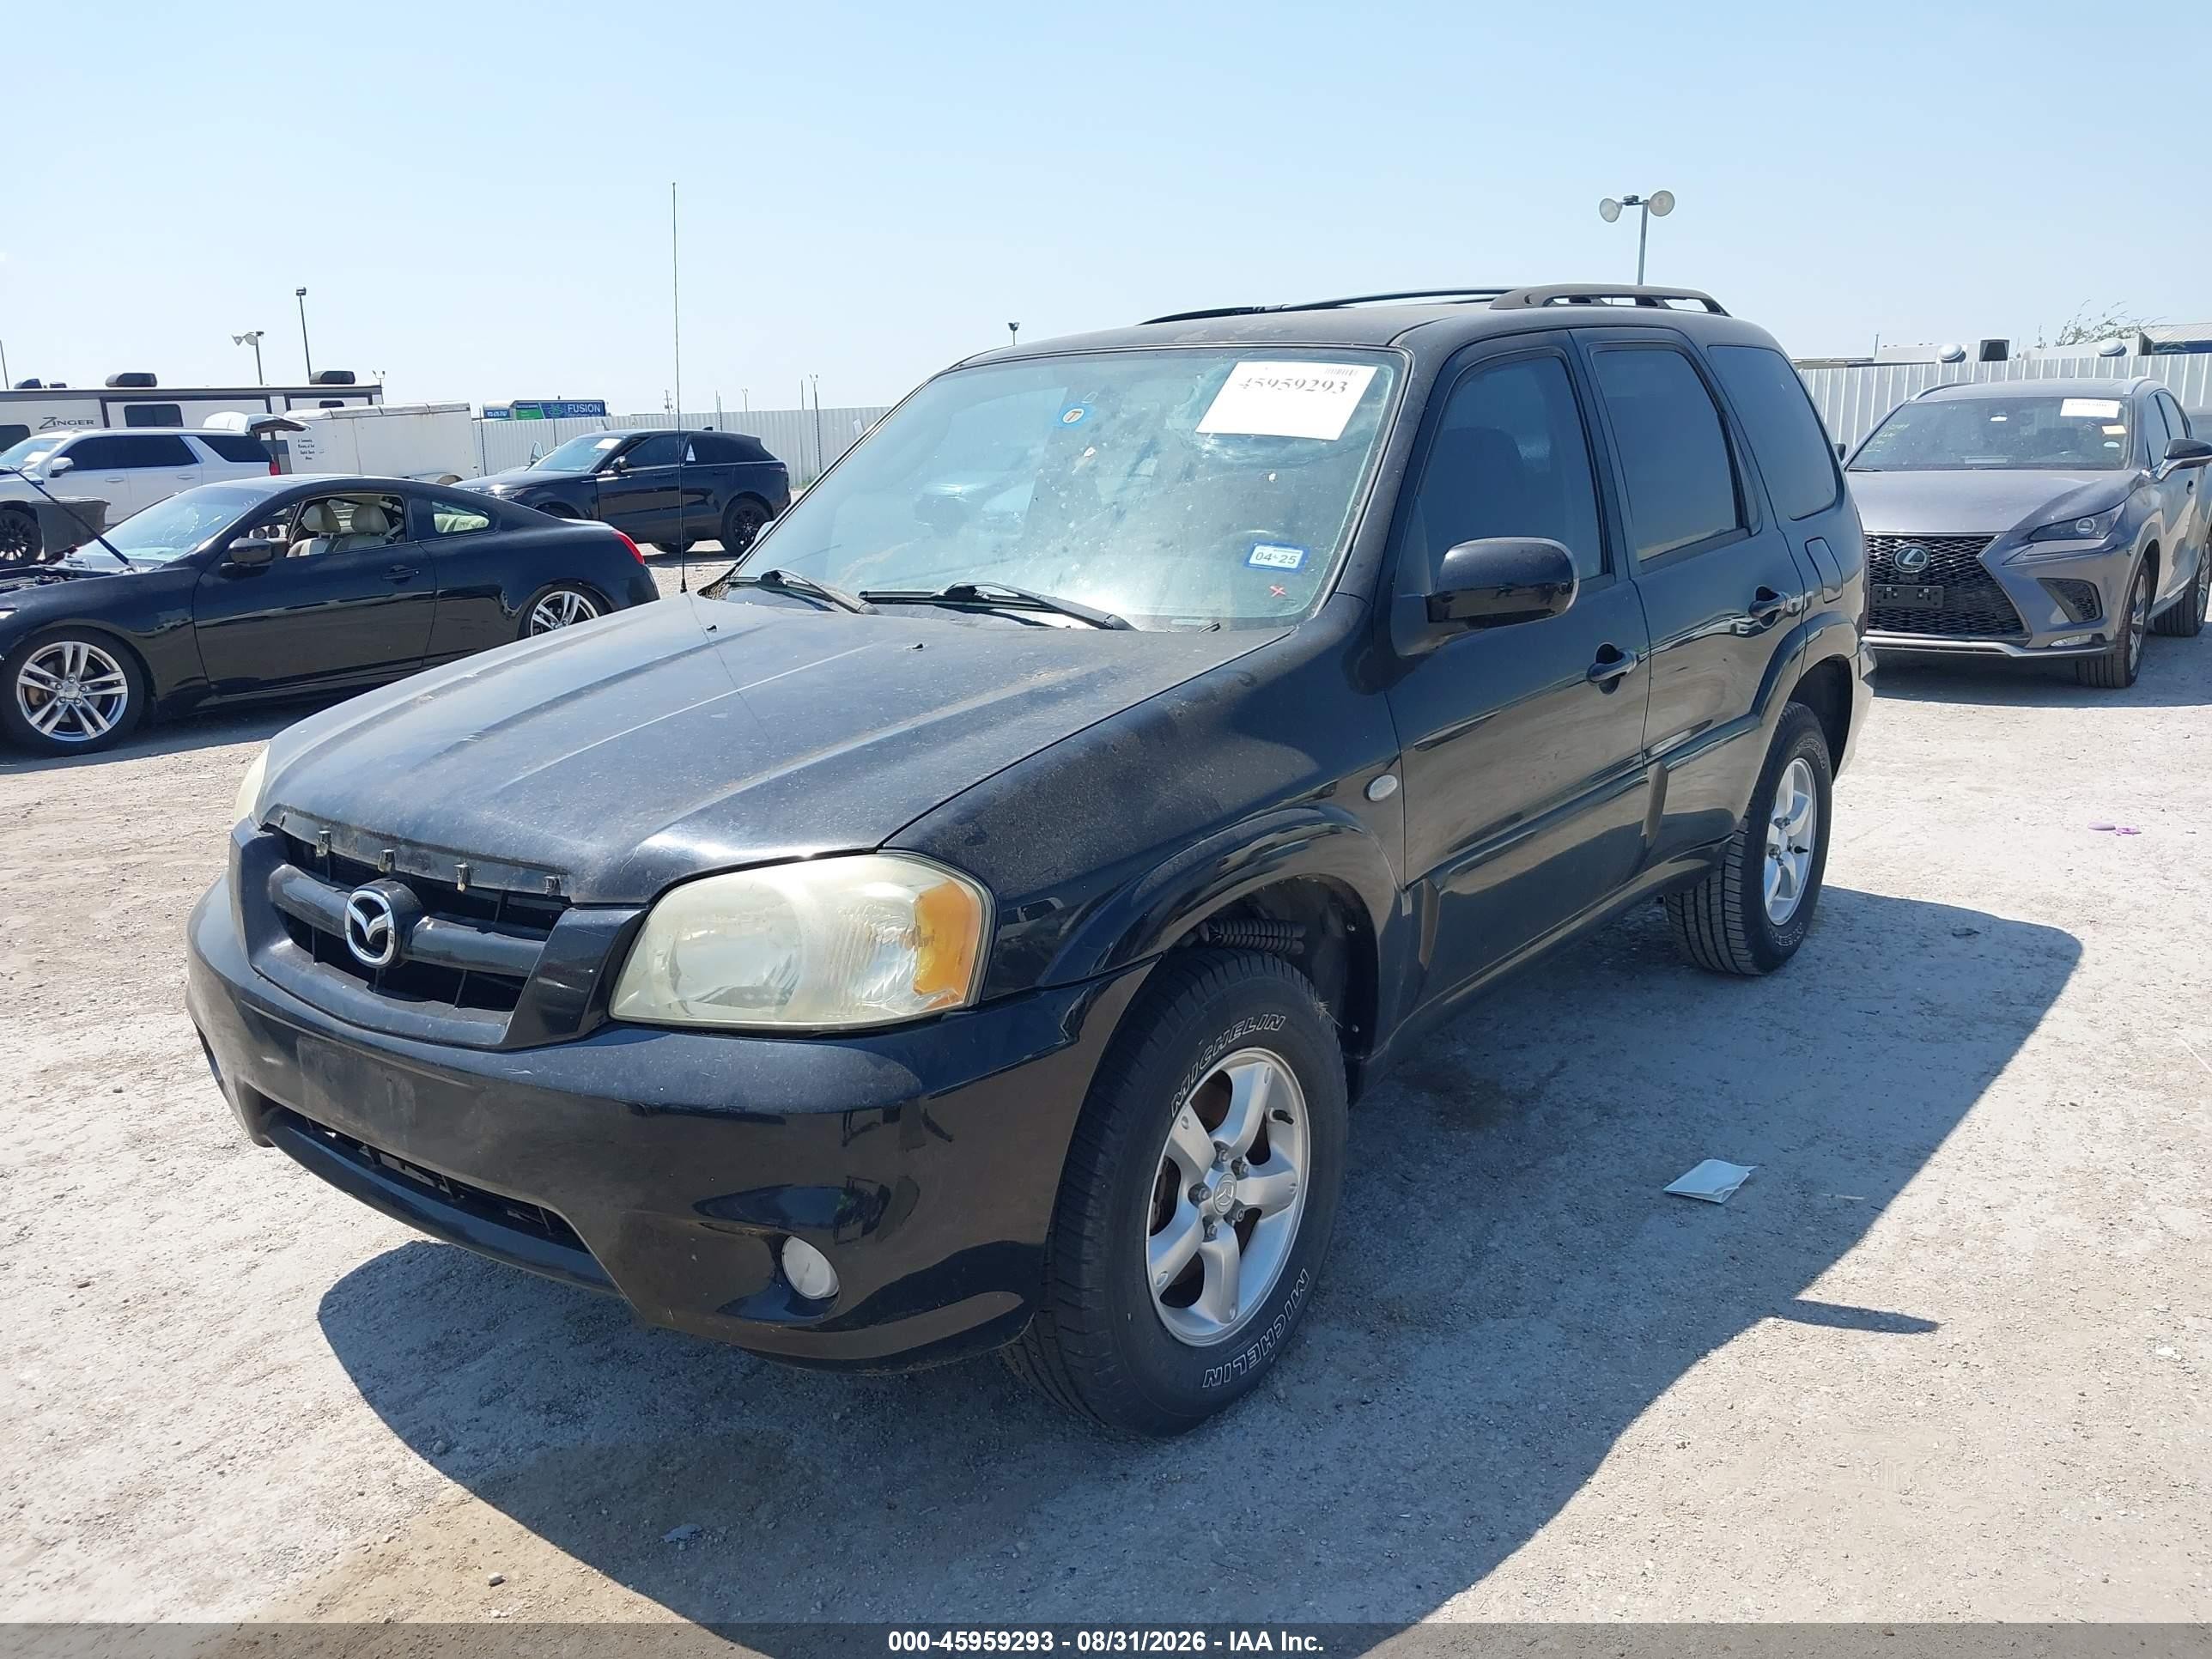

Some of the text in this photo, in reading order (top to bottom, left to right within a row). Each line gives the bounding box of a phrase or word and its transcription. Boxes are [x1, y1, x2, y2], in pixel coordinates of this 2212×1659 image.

[567, 404, 602, 413] FUSION
[1170, 1013, 1286, 1118] MICHELIN
[1202, 1267, 1310, 1389] MICHELIN
